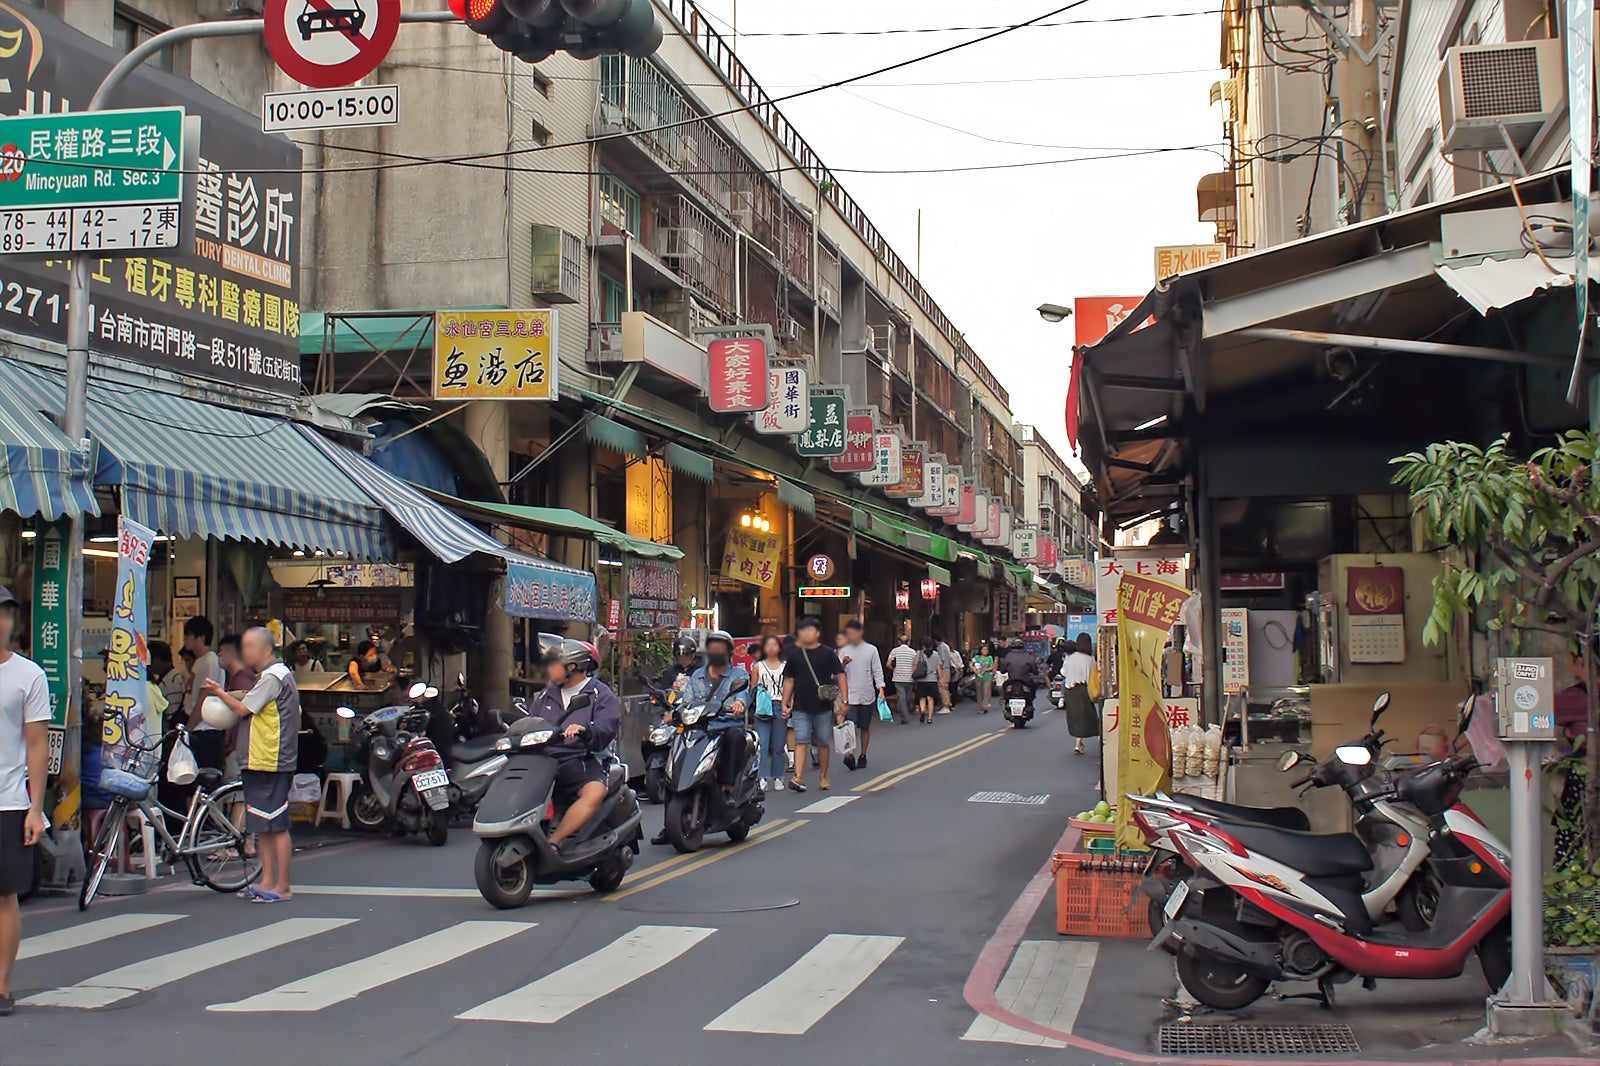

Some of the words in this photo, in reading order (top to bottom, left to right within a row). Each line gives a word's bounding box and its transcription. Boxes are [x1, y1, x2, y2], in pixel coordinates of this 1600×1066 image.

[269, 95, 393, 122] 10:00-15:00
[28, 125, 161, 159] 民權路三段
[0, 150, 25, 174] 20
[25, 173, 87, 193] Mincyuan
[94, 170, 116, 187] Rd.
[122, 168, 160, 186] Sec.3
[46, 211, 67, 229] 44
[142, 207, 153, 226] 2
[157, 206, 178, 230] 東
[195, 157, 294, 262] 醫診所
[46, 232, 67, 250] 47
[130, 229, 152, 247] 17
[194, 236, 222, 262] TURY
[223, 247, 261, 276] DENTAL
[262, 261, 292, 285] CLINIC
[444, 318, 545, 338] 水仙宮三兄弟
[441, 345, 545, 389] 魚湯店
[724, 341, 753, 409] 大家好素食
[784, 370, 800, 420] 國華街
[799, 428, 843, 449] 鳳梨店
[1101, 559, 1180, 577] 大上海
